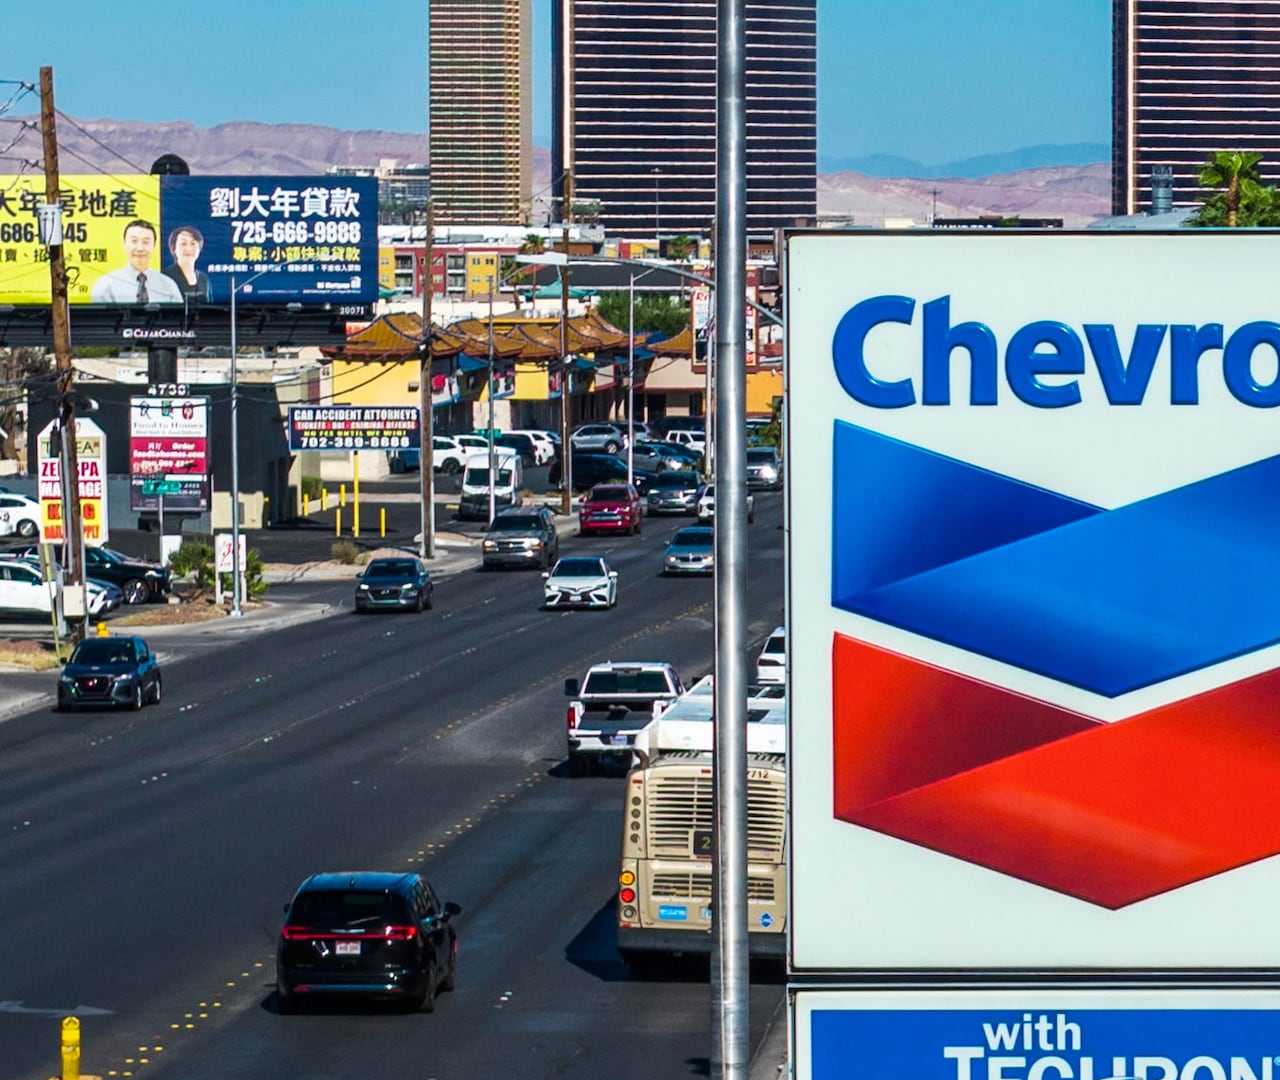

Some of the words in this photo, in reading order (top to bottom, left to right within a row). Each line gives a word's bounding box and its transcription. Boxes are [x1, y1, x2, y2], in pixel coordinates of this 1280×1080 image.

[210, 187, 361, 218] 劉大年貸款
[231, 221, 361, 244] 725-666-9888
[294, 410, 313, 420] CAR
[315, 410, 362, 420] ACCIDENT
[364, 409, 418, 420] ATTORNEYS
[982, 1013, 1082, 1051] with
